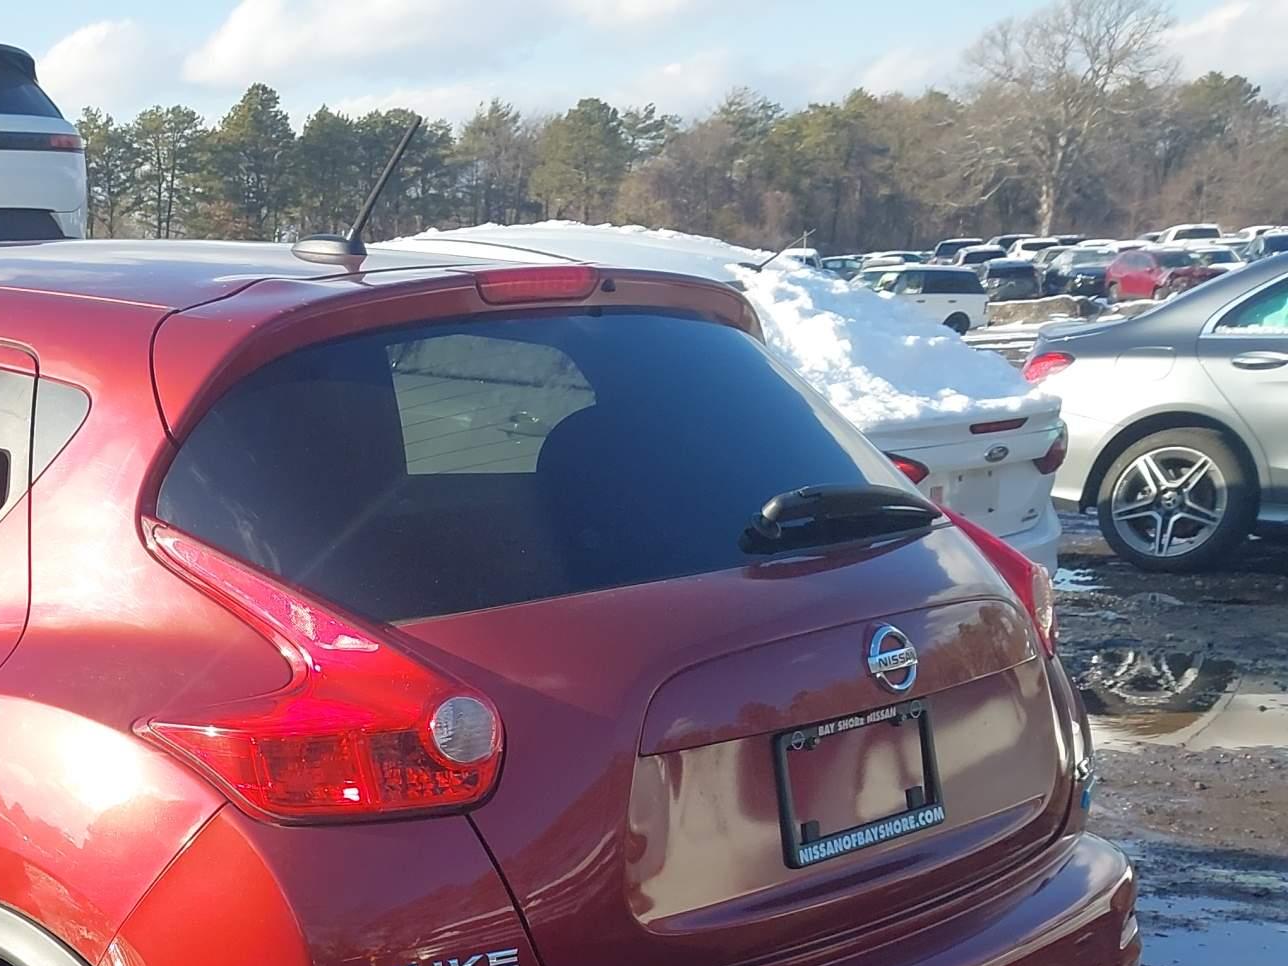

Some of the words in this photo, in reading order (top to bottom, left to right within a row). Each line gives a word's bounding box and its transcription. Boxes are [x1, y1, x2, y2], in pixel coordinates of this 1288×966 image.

[878, 647, 916, 669] NISSAN
[818, 722, 835, 736] BAY
[838, 716, 864, 731] SHORE
[867, 707, 896, 723] NISSAN
[799, 806, 944, 864] NISSANOFBAYSHORE.COM
